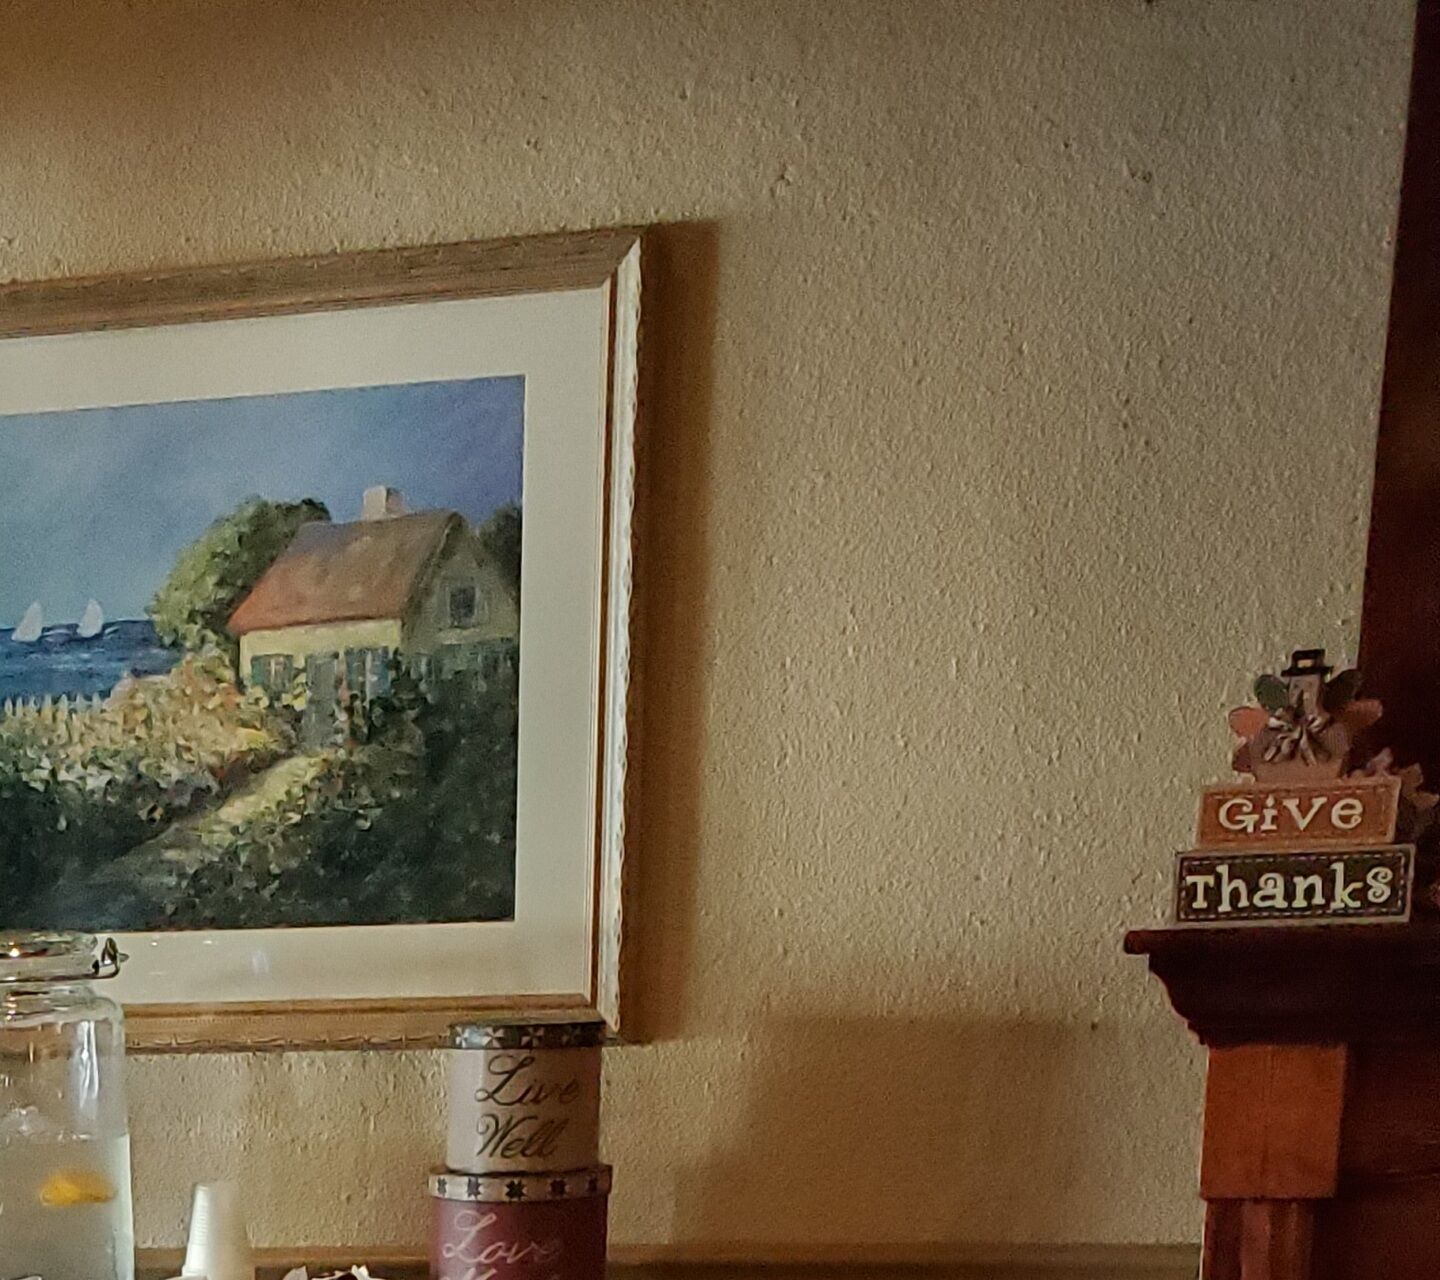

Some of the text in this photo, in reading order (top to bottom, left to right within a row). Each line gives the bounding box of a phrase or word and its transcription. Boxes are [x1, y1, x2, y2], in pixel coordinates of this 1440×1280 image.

[1185, 861, 1394, 912] Thanks
[474, 1055, 580, 1106] Live
[476, 1113, 570, 1159] Well
